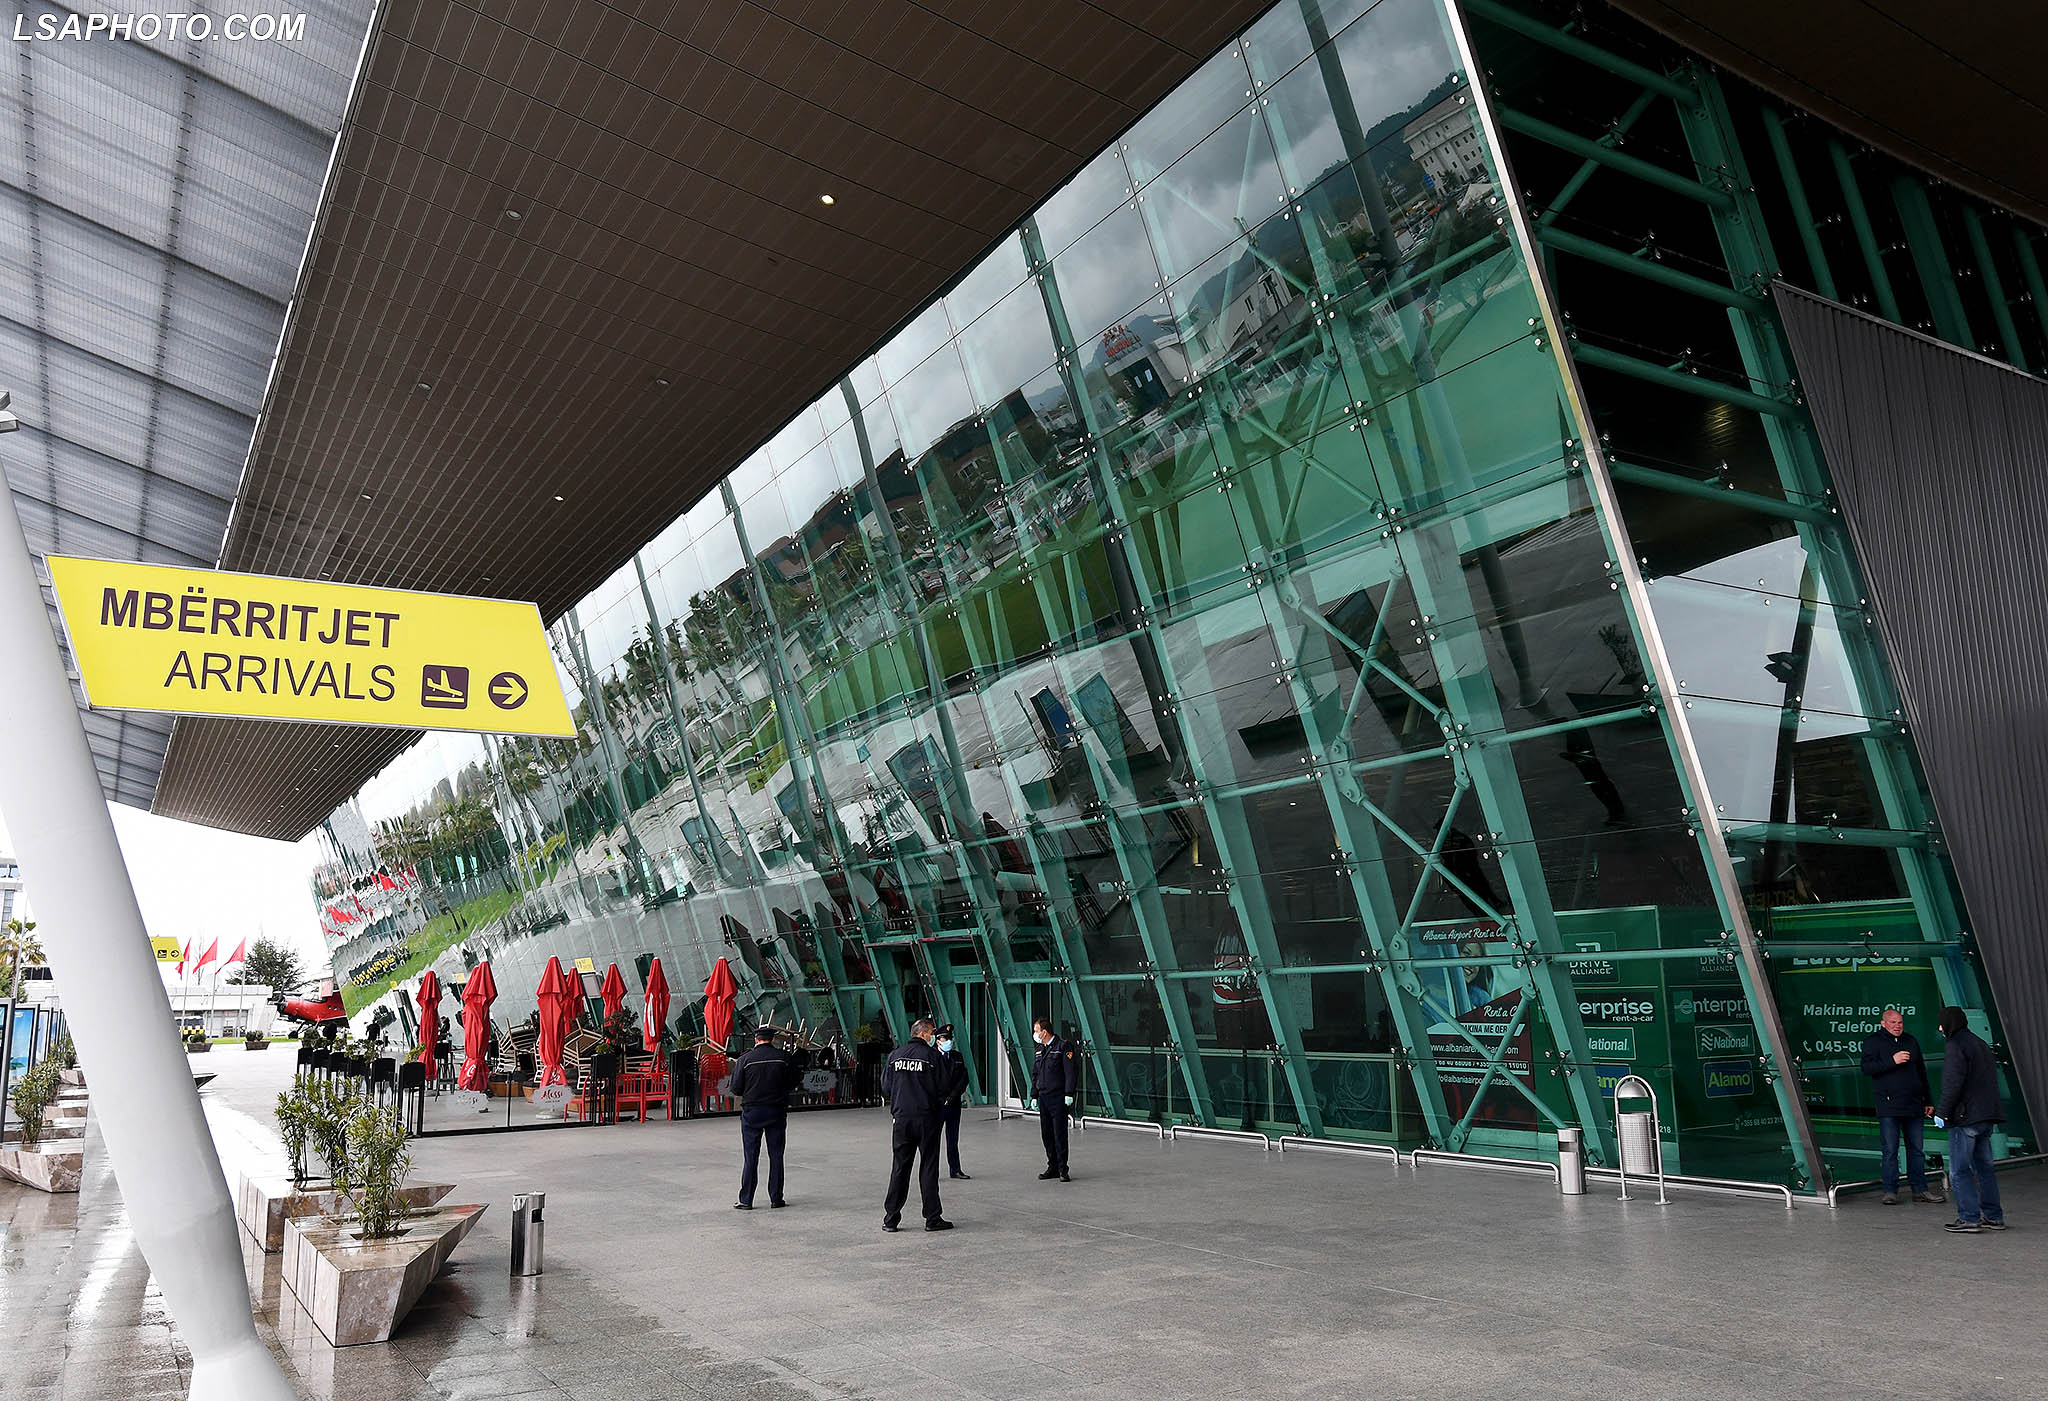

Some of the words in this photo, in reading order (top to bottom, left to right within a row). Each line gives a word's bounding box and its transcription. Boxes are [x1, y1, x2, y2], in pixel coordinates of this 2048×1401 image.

[100, 586, 400, 648] MBËRRITJET
[164, 650, 396, 702] ARRIVALS
[1422, 929, 1447, 941] Albania
[1448, 928, 1472, 942] Airport
[1473, 927, 1490, 938] Rent
[1569, 960, 1611, 968] DRIVE
[1699, 954, 1735, 965] DRIVE
[1570, 967, 1611, 975] ALLIANCE
[1484, 1006, 1501, 1017] Rent
[1502, 1009, 1508, 1017] a
[1578, 998, 1653, 1019] erprise
[1680, 998, 1751, 1016] enterpri
[1803, 1003, 1853, 1016] Makina
[1858, 1007, 1880, 1015] me
[1464, 1025, 1482, 1034] AKINA
[1484, 1025, 1494, 1033] ME
[1830, 1021, 1881, 1032] Telefon
[1713, 1036, 1748, 1049] National
[895, 1060, 922, 1072] POLICIA
[1708, 1071, 1750, 1088] Alamo
[1659, 1125, 1671, 1133] 218
